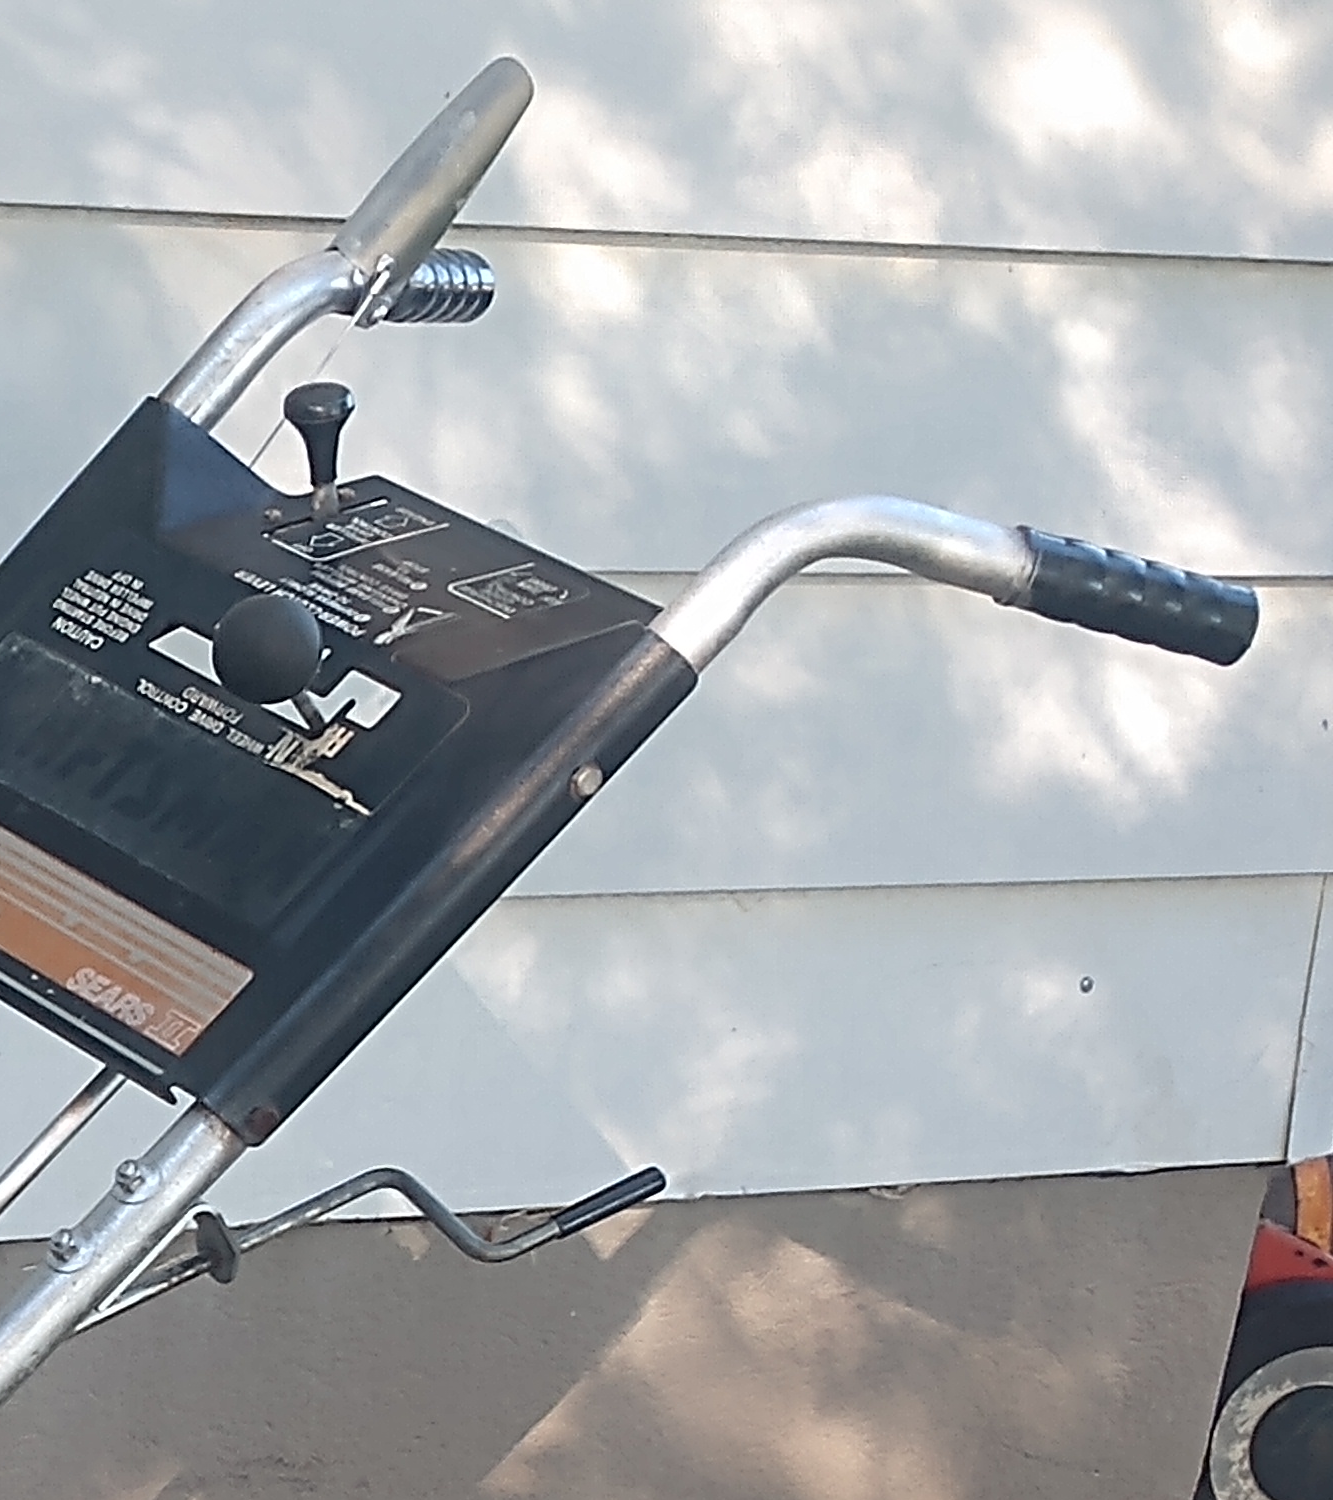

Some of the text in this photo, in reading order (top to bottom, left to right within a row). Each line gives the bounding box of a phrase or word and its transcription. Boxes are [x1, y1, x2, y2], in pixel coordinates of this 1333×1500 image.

[51, 616, 105, 650] CAUTION
[136, 678, 189, 714] CONTROL
[182, 686, 244, 725] FORWARD
[188, 708, 225, 734] DRIVE
[225, 726, 265, 755] WHEEL
[65, 967, 155, 1026] SEARS
